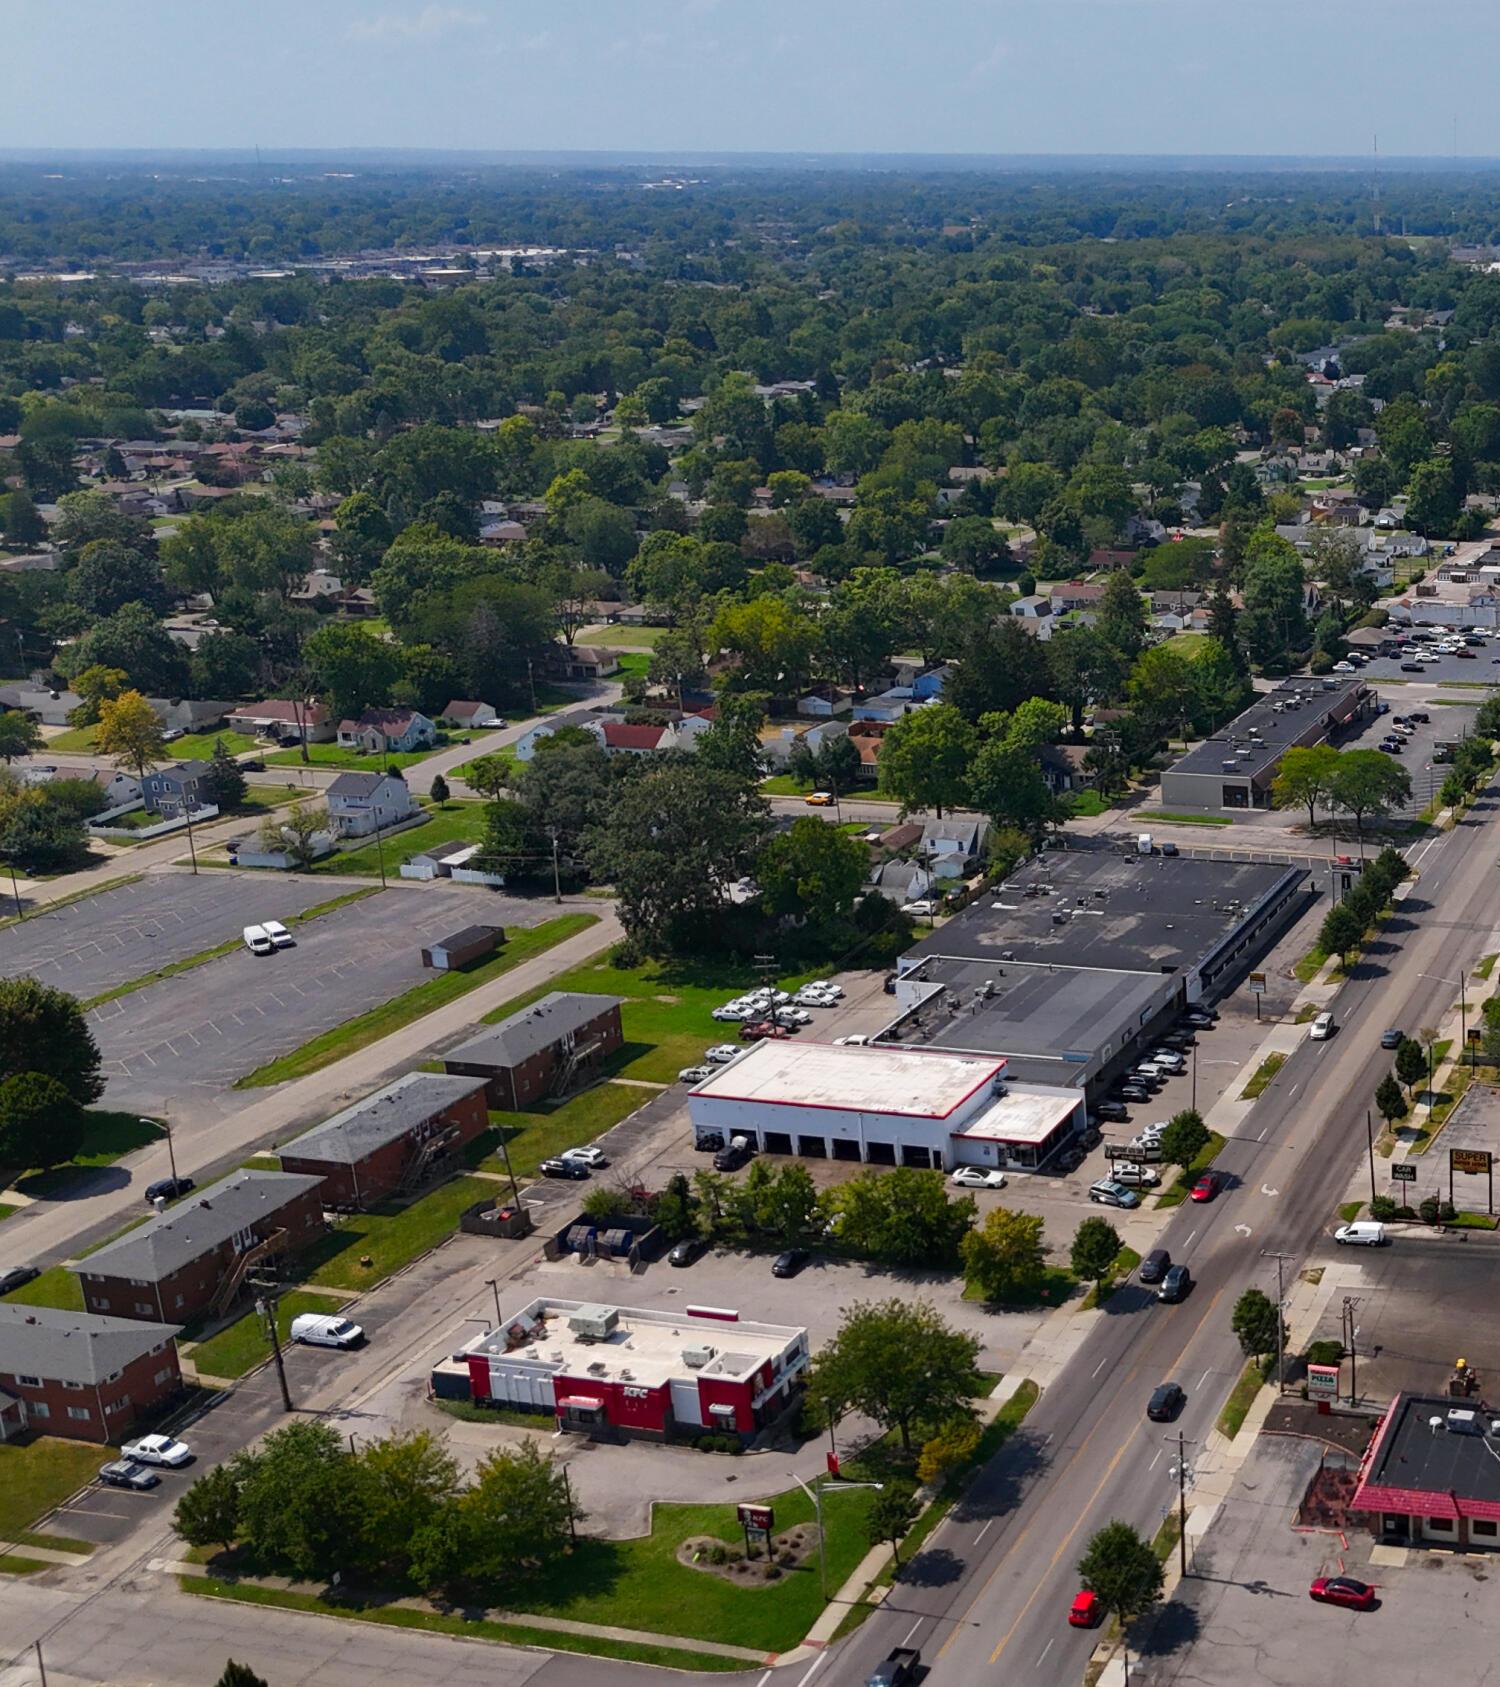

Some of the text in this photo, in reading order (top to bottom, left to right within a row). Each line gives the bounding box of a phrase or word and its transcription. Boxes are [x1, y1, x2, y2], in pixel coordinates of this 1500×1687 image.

[1455, 1152, 1486, 1162] SUPER
[1312, 1375, 1334, 1383] PIZZA
[623, 1386, 648, 1398] KFC
